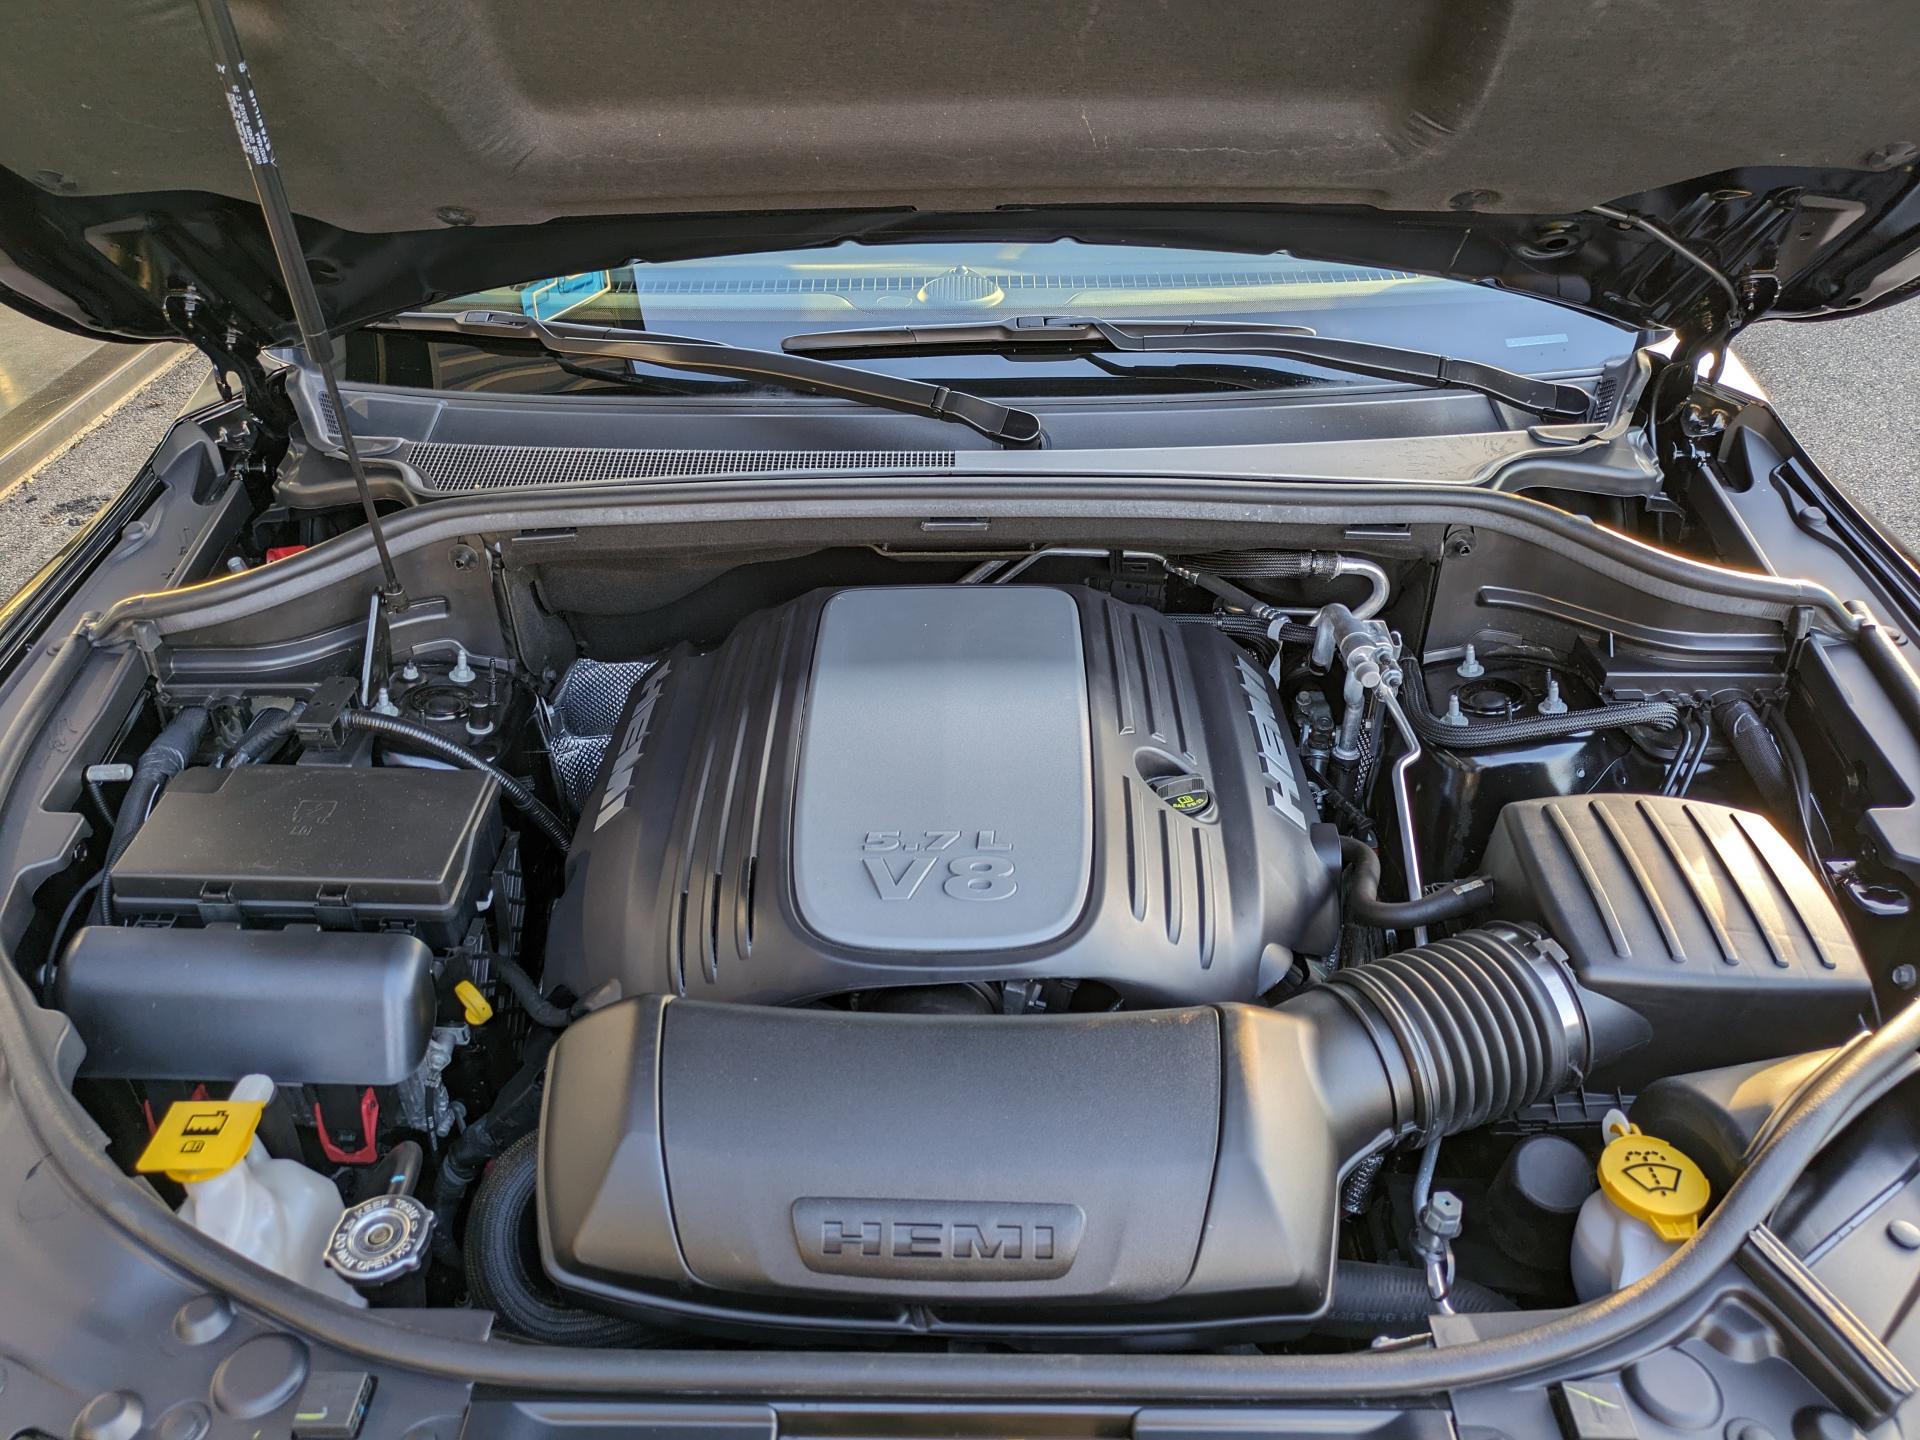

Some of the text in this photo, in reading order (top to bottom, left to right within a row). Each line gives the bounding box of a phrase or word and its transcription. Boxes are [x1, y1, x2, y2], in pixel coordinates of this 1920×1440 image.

[249, 90, 270, 152] STABILUS
[594, 660, 671, 832] HEMI
[1235, 655, 1306, 831] HEMI
[862, 830, 1013, 851] 5.7 L
[861, 856, 1017, 901] V8
[355, 1199, 390, 1218] KEEP
[334, 1233, 416, 1272] DO NOT OPEN HOT
[822, 1220, 1054, 1259] HEMI
